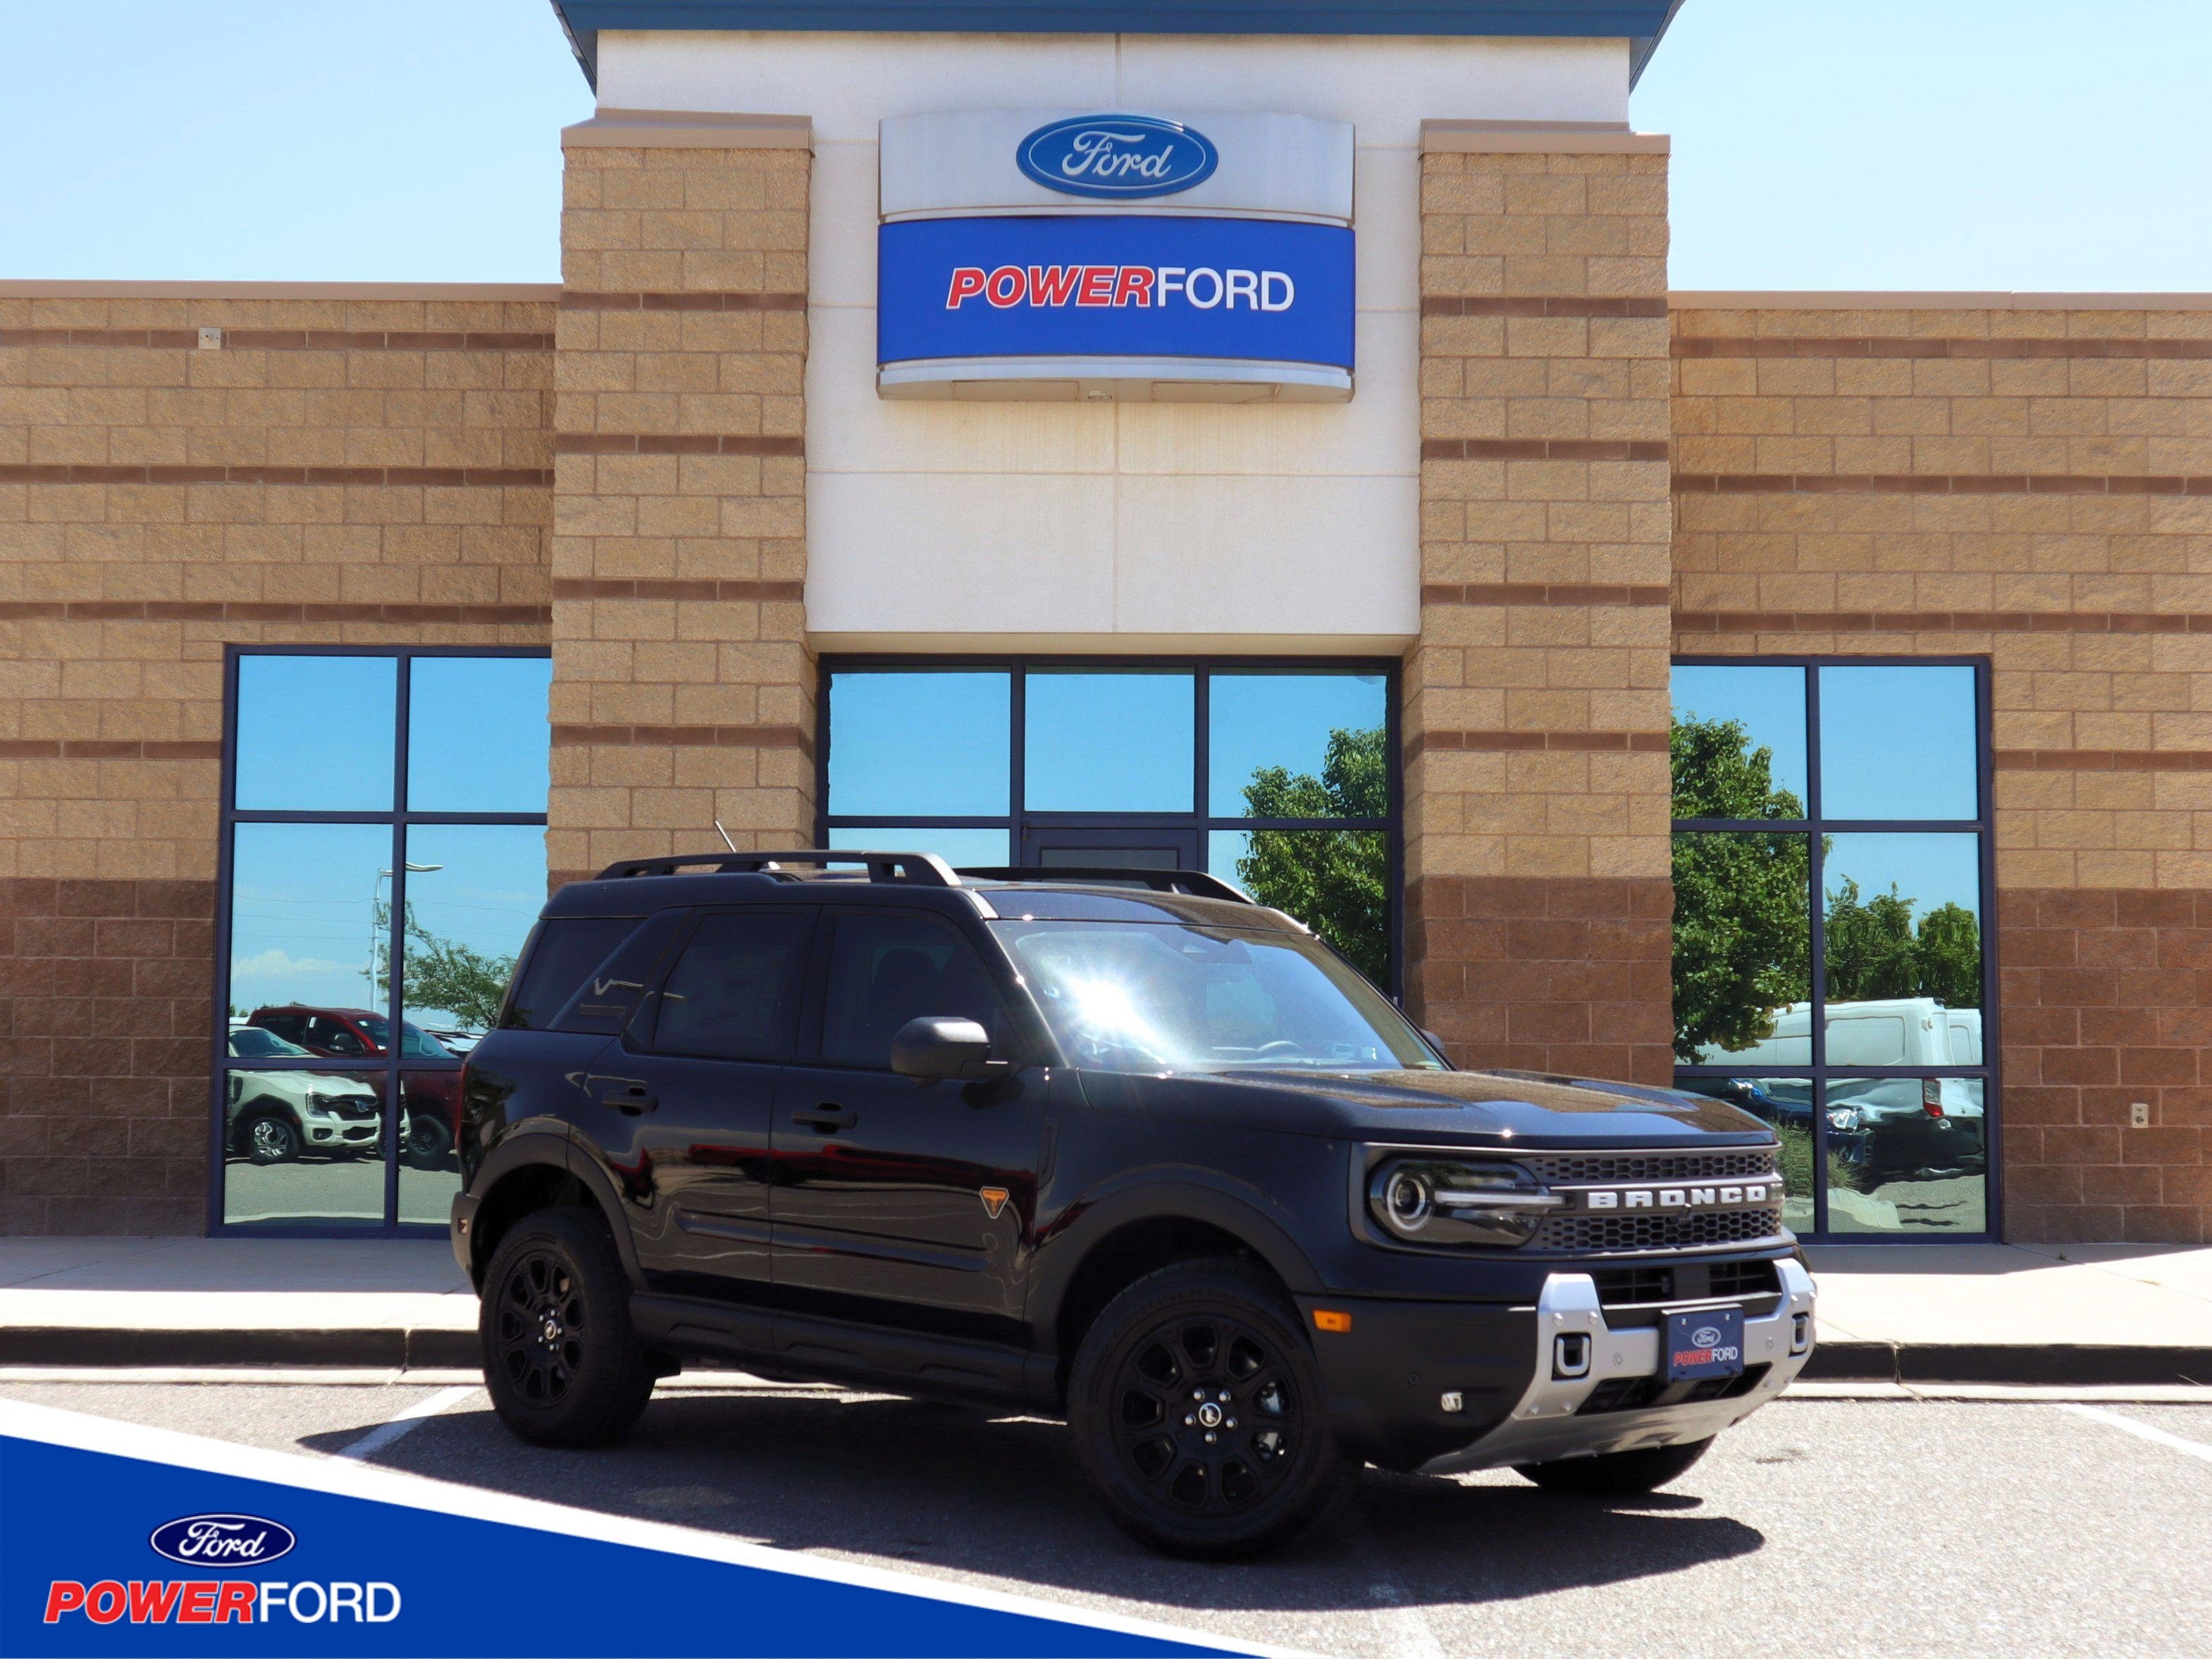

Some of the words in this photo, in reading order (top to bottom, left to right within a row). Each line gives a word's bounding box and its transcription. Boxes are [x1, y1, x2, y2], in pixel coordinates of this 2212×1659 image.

[1061, 130, 1173, 179] Ford
[946, 265, 1295, 312] POWERFORD
[1587, 1185, 1767, 1209] BRONCO
[1697, 1330, 1716, 1344] Ford
